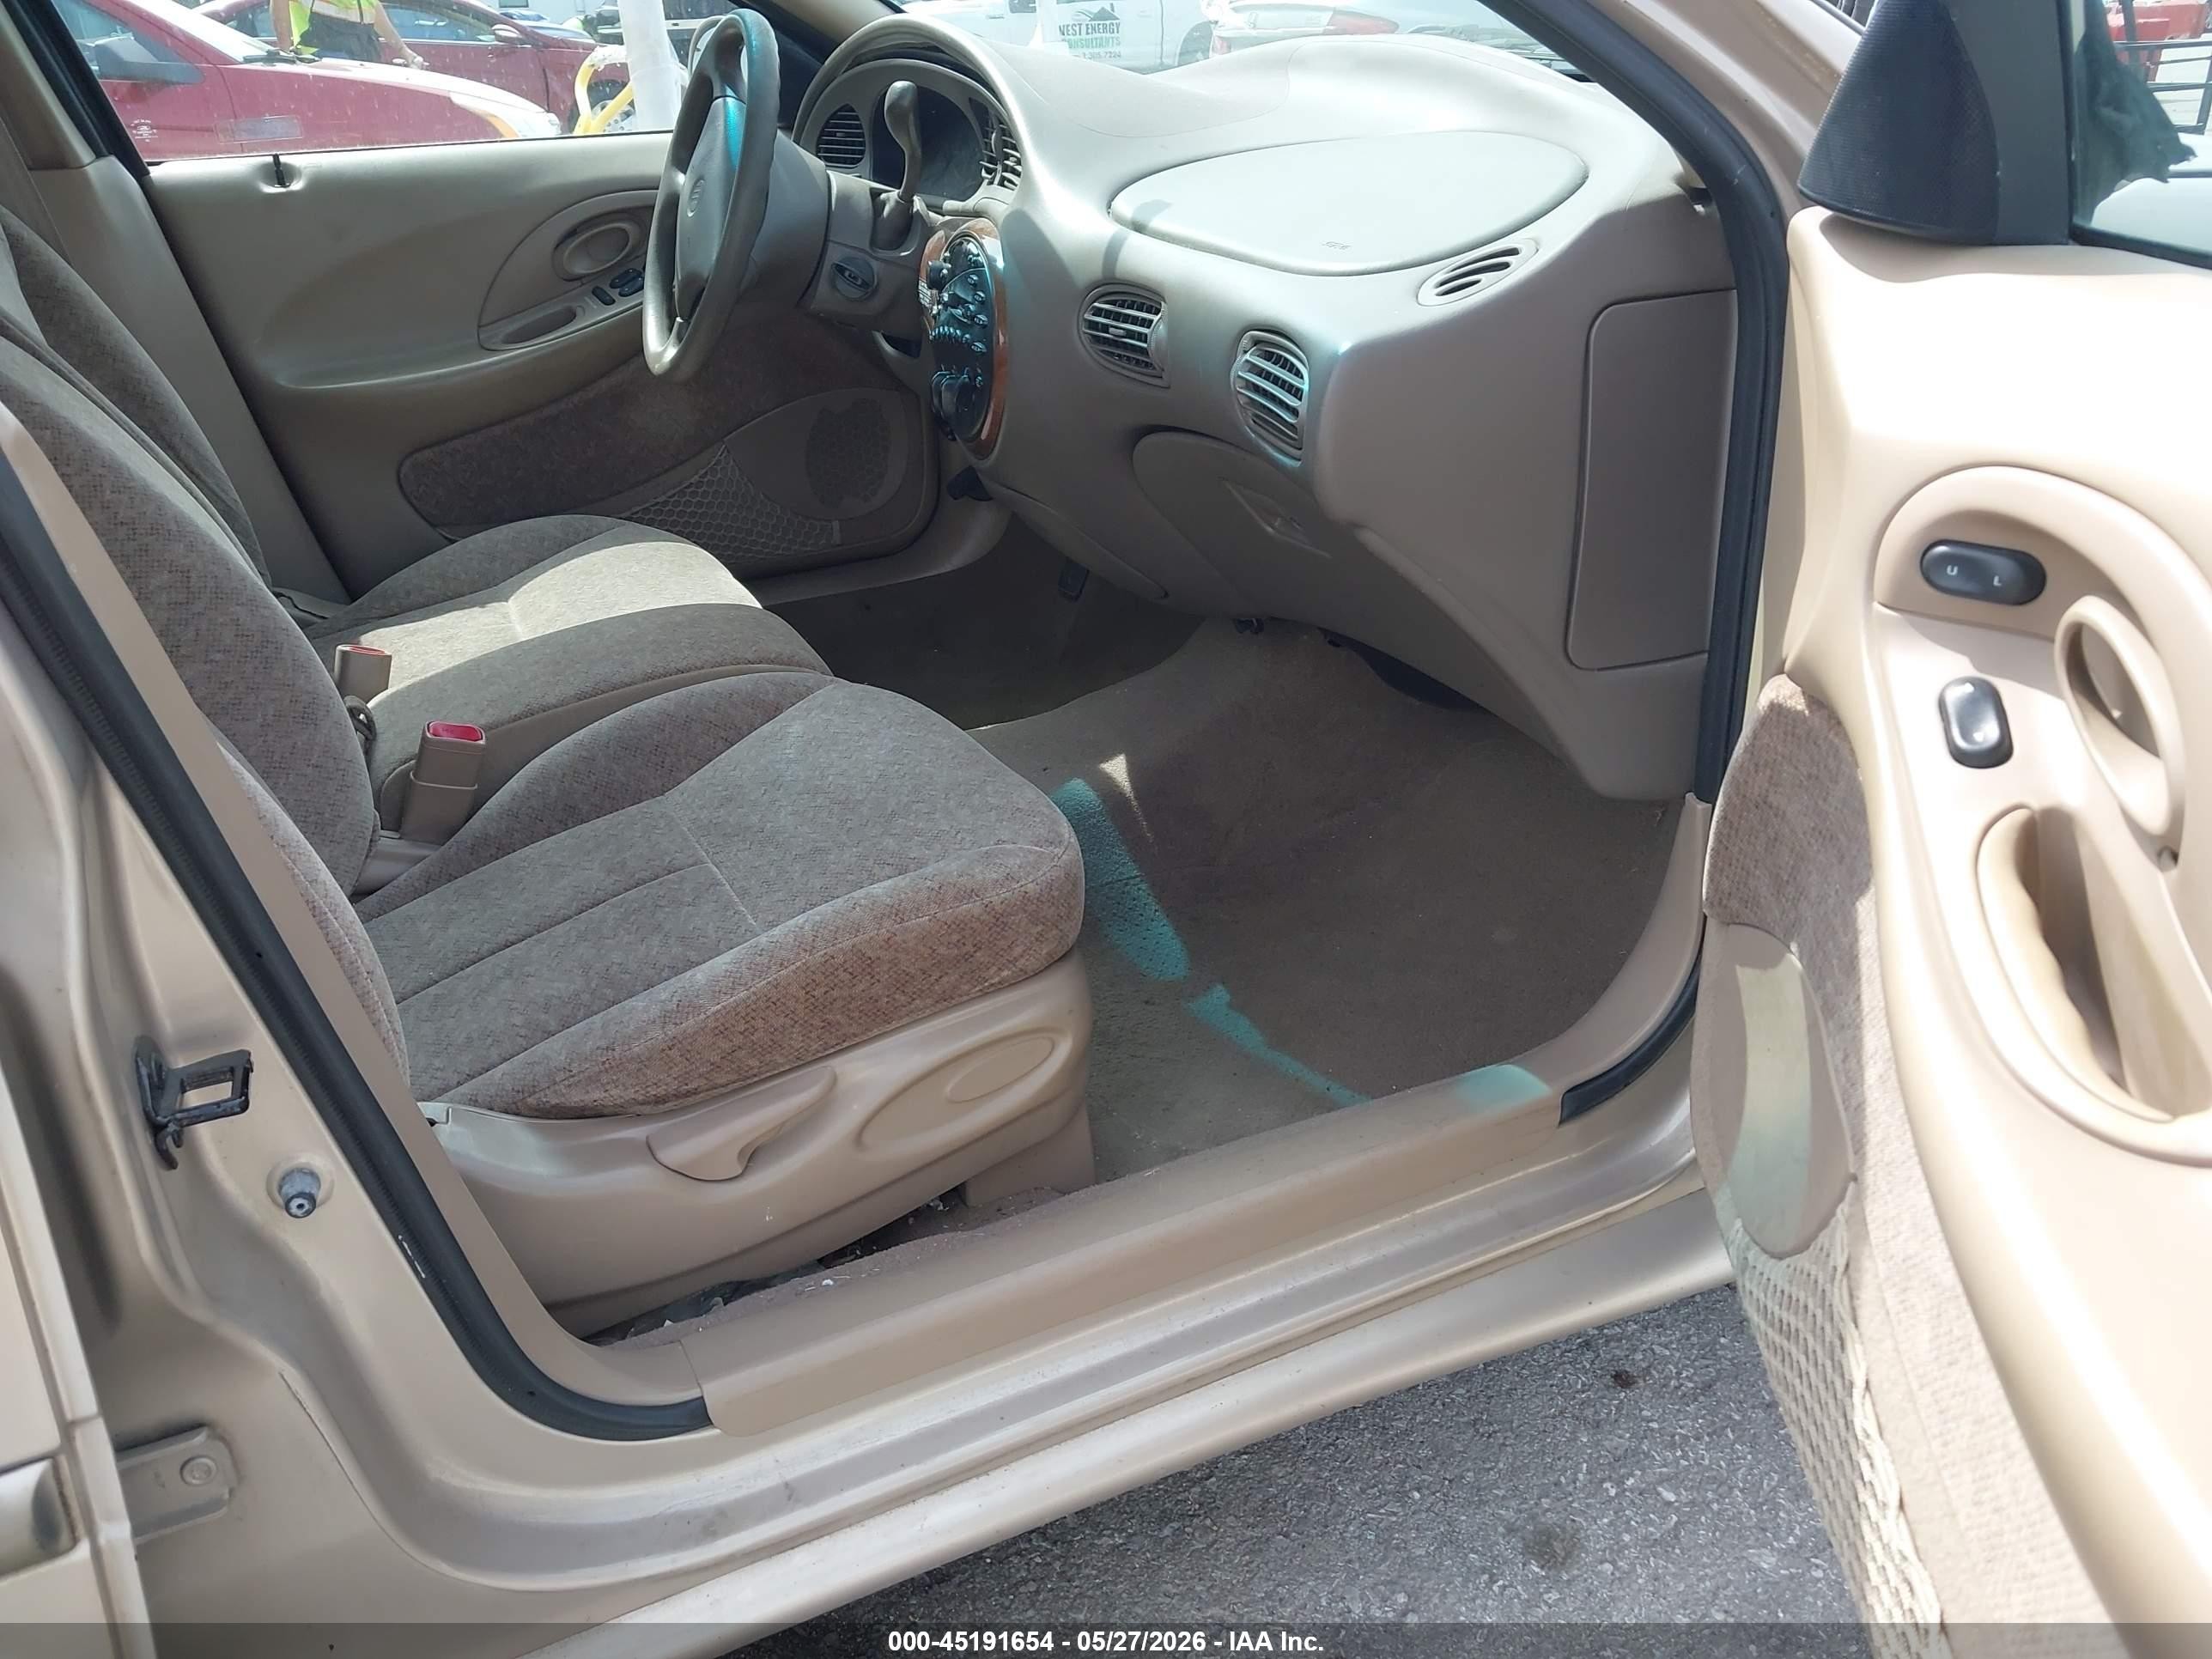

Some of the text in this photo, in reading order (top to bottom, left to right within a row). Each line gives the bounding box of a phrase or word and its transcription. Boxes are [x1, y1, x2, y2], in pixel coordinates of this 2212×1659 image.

[1085, 21, 1121, 35] ENERGY
[1947, 565, 2002, 586] U L
